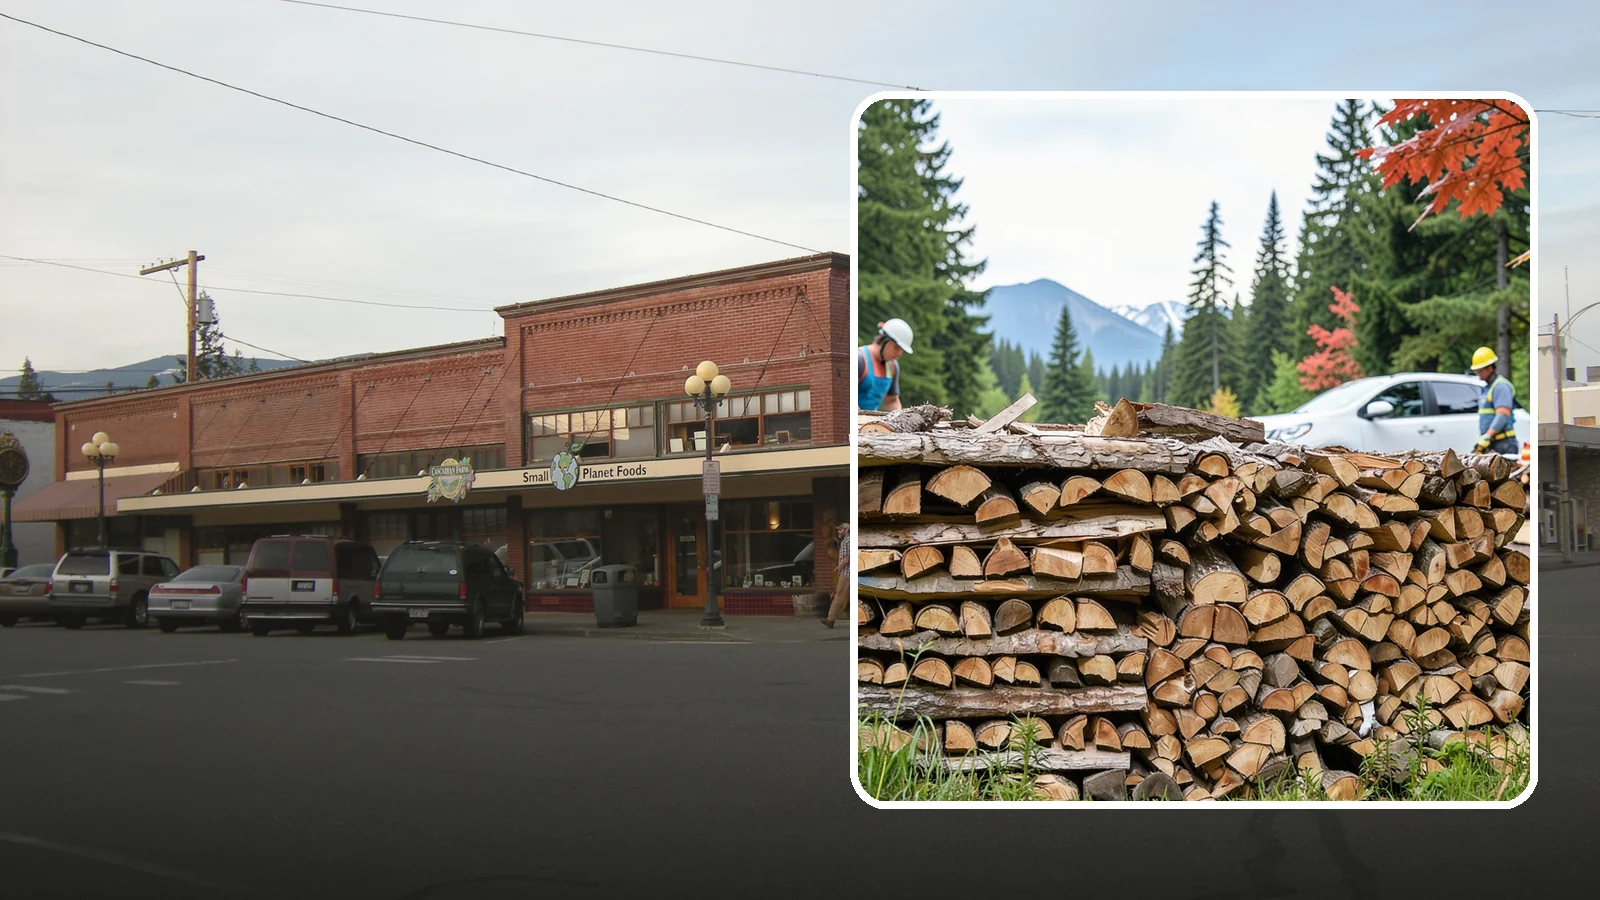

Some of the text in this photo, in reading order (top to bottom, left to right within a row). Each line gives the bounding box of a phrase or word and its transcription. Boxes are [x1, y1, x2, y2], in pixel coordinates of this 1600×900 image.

[523, 464, 647, 483] Small Planet Foods
